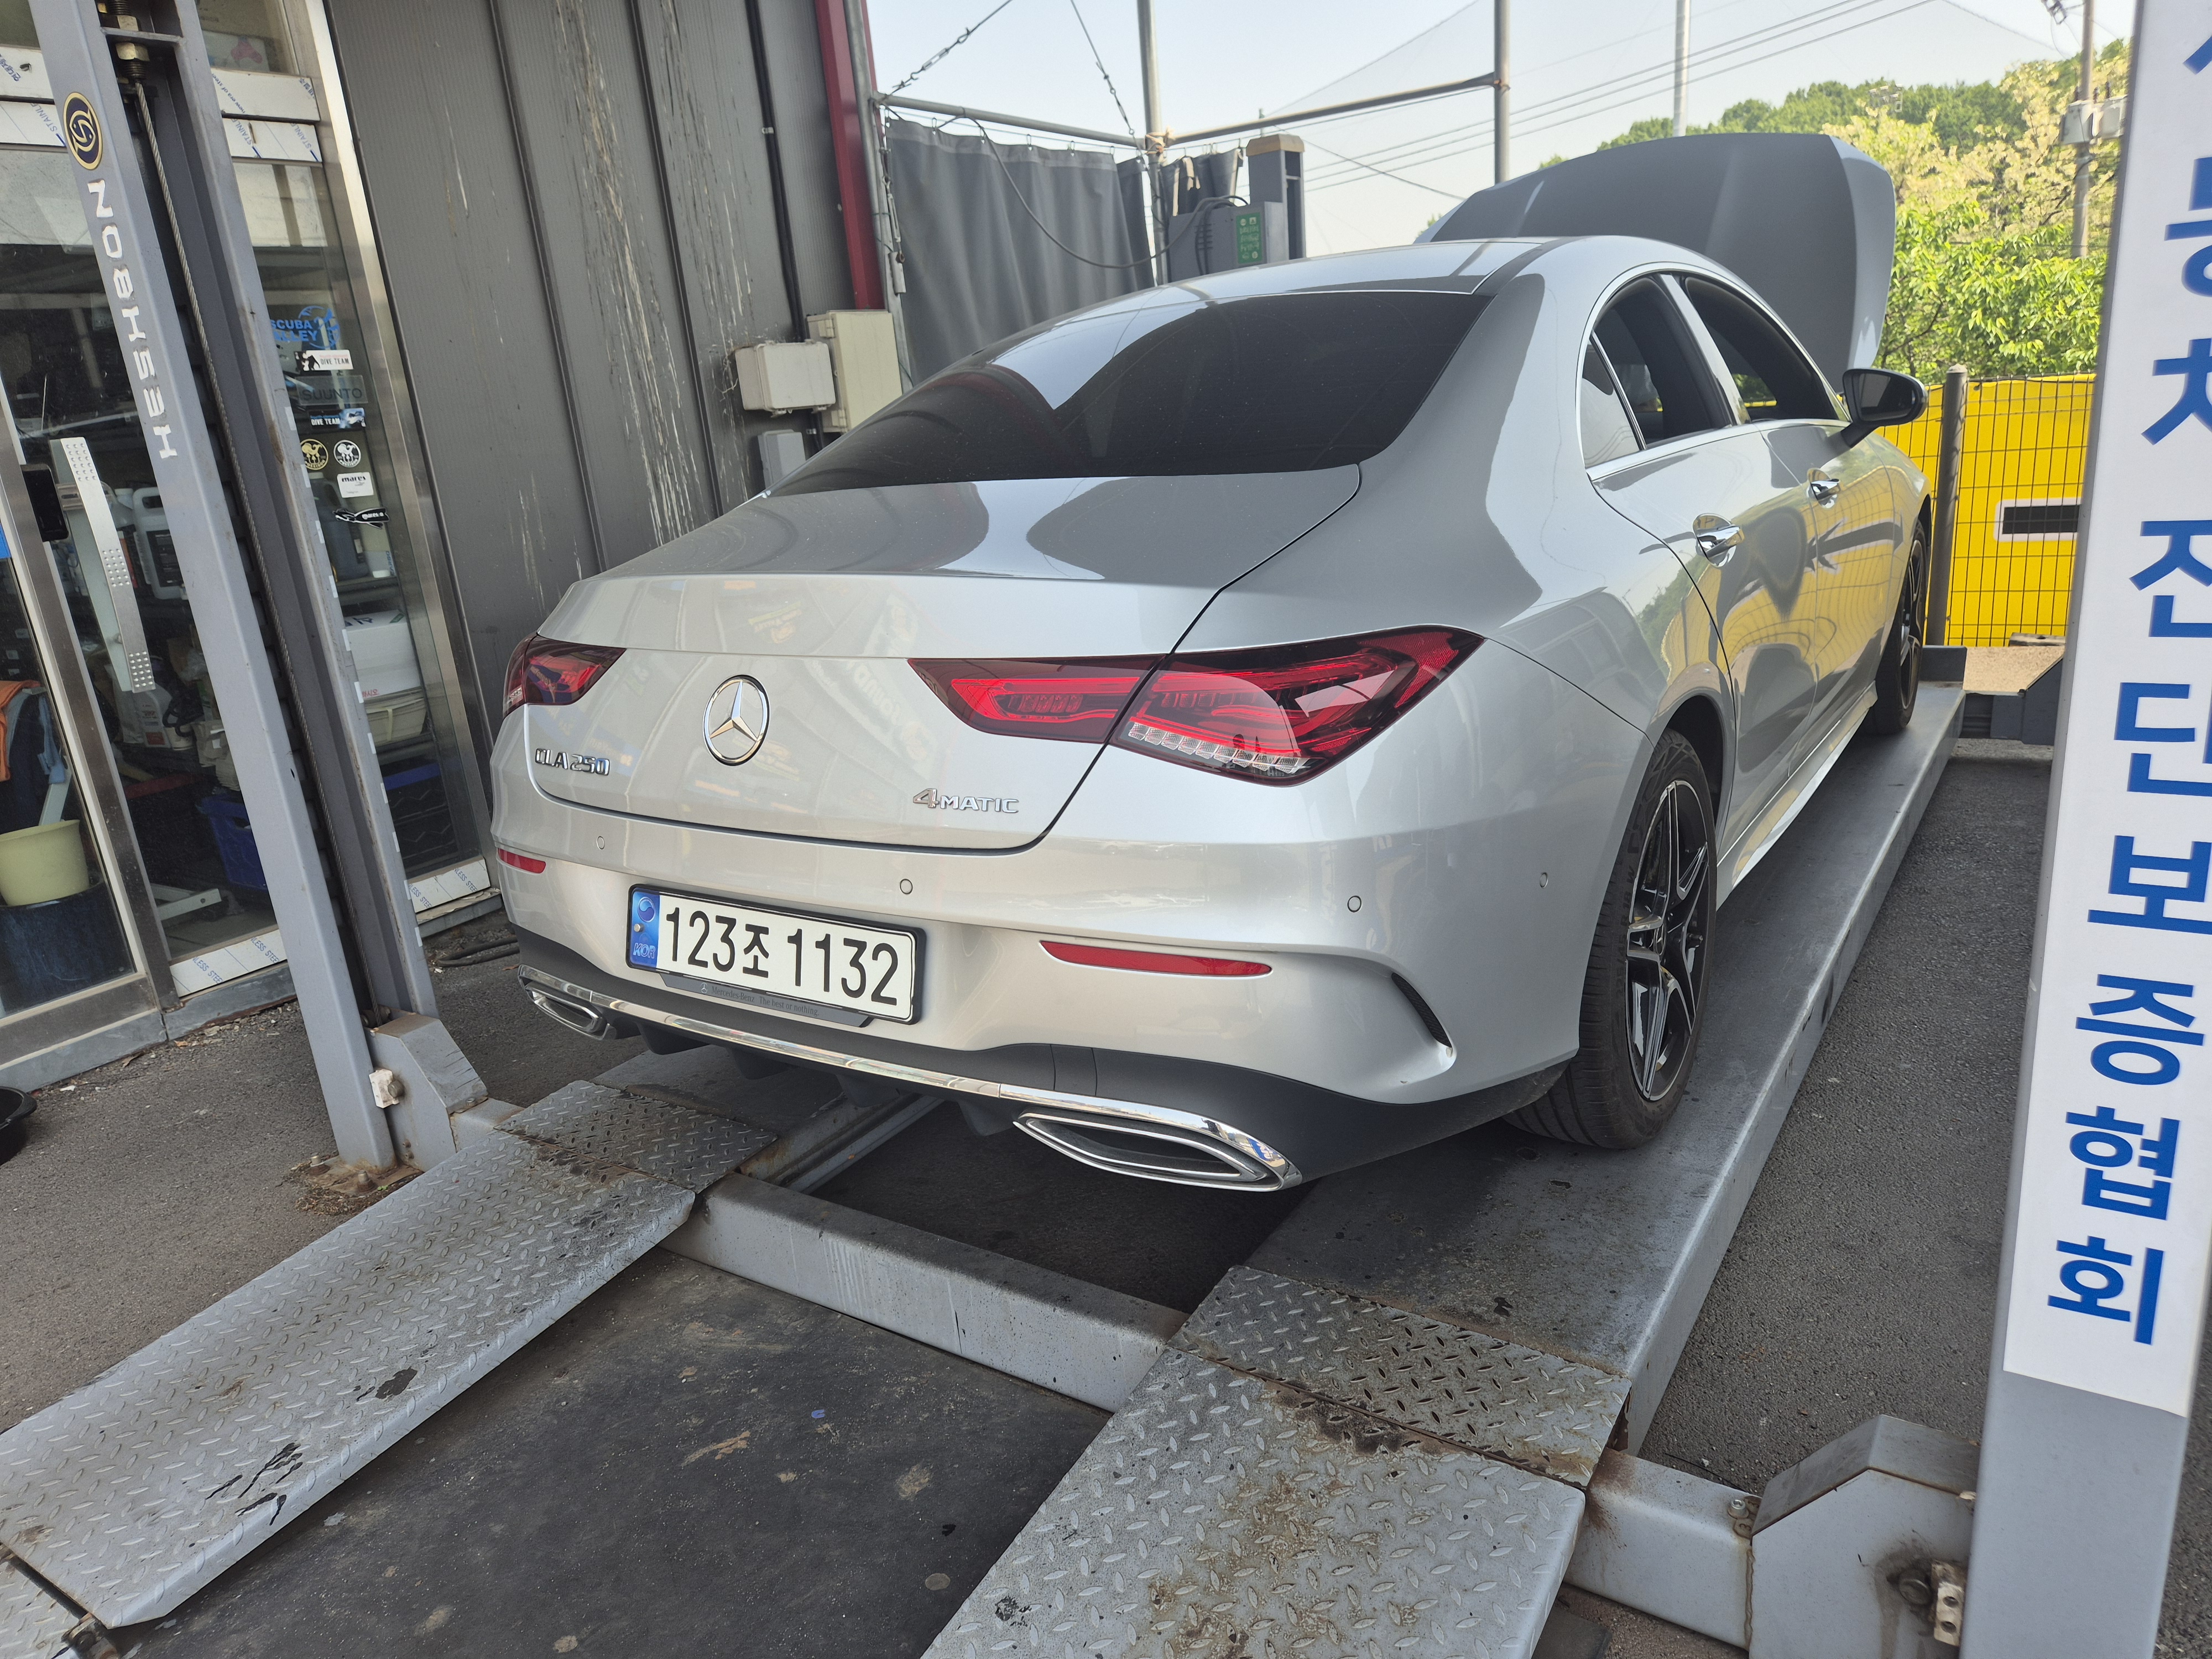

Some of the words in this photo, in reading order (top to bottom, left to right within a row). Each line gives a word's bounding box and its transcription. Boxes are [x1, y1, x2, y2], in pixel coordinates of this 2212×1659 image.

[227, 92, 237, 103] era
[235, 102, 246, 114] new
[87, 179, 178, 459] HESHBON
[270, 319, 313, 330] SCUBA
[273, 330, 318, 342] ALLEY
[301, 388, 362, 400] SUUNTO
[324, 417, 341, 425] TEAM
[535, 748, 568, 770] CLA
[570, 754, 611, 776] 250
[912, 788, 1019, 813] 4MATIC
[633, 942, 656, 959] KOR
[666, 907, 770, 978] 123조
[787, 928, 899, 1006] 1132
[711, 985, 755, 1003] Mercedes-Benz
[759, 996, 770, 1006] The
[771, 998, 784, 1009] best
[794, 1004, 820, 1017] nothing.
